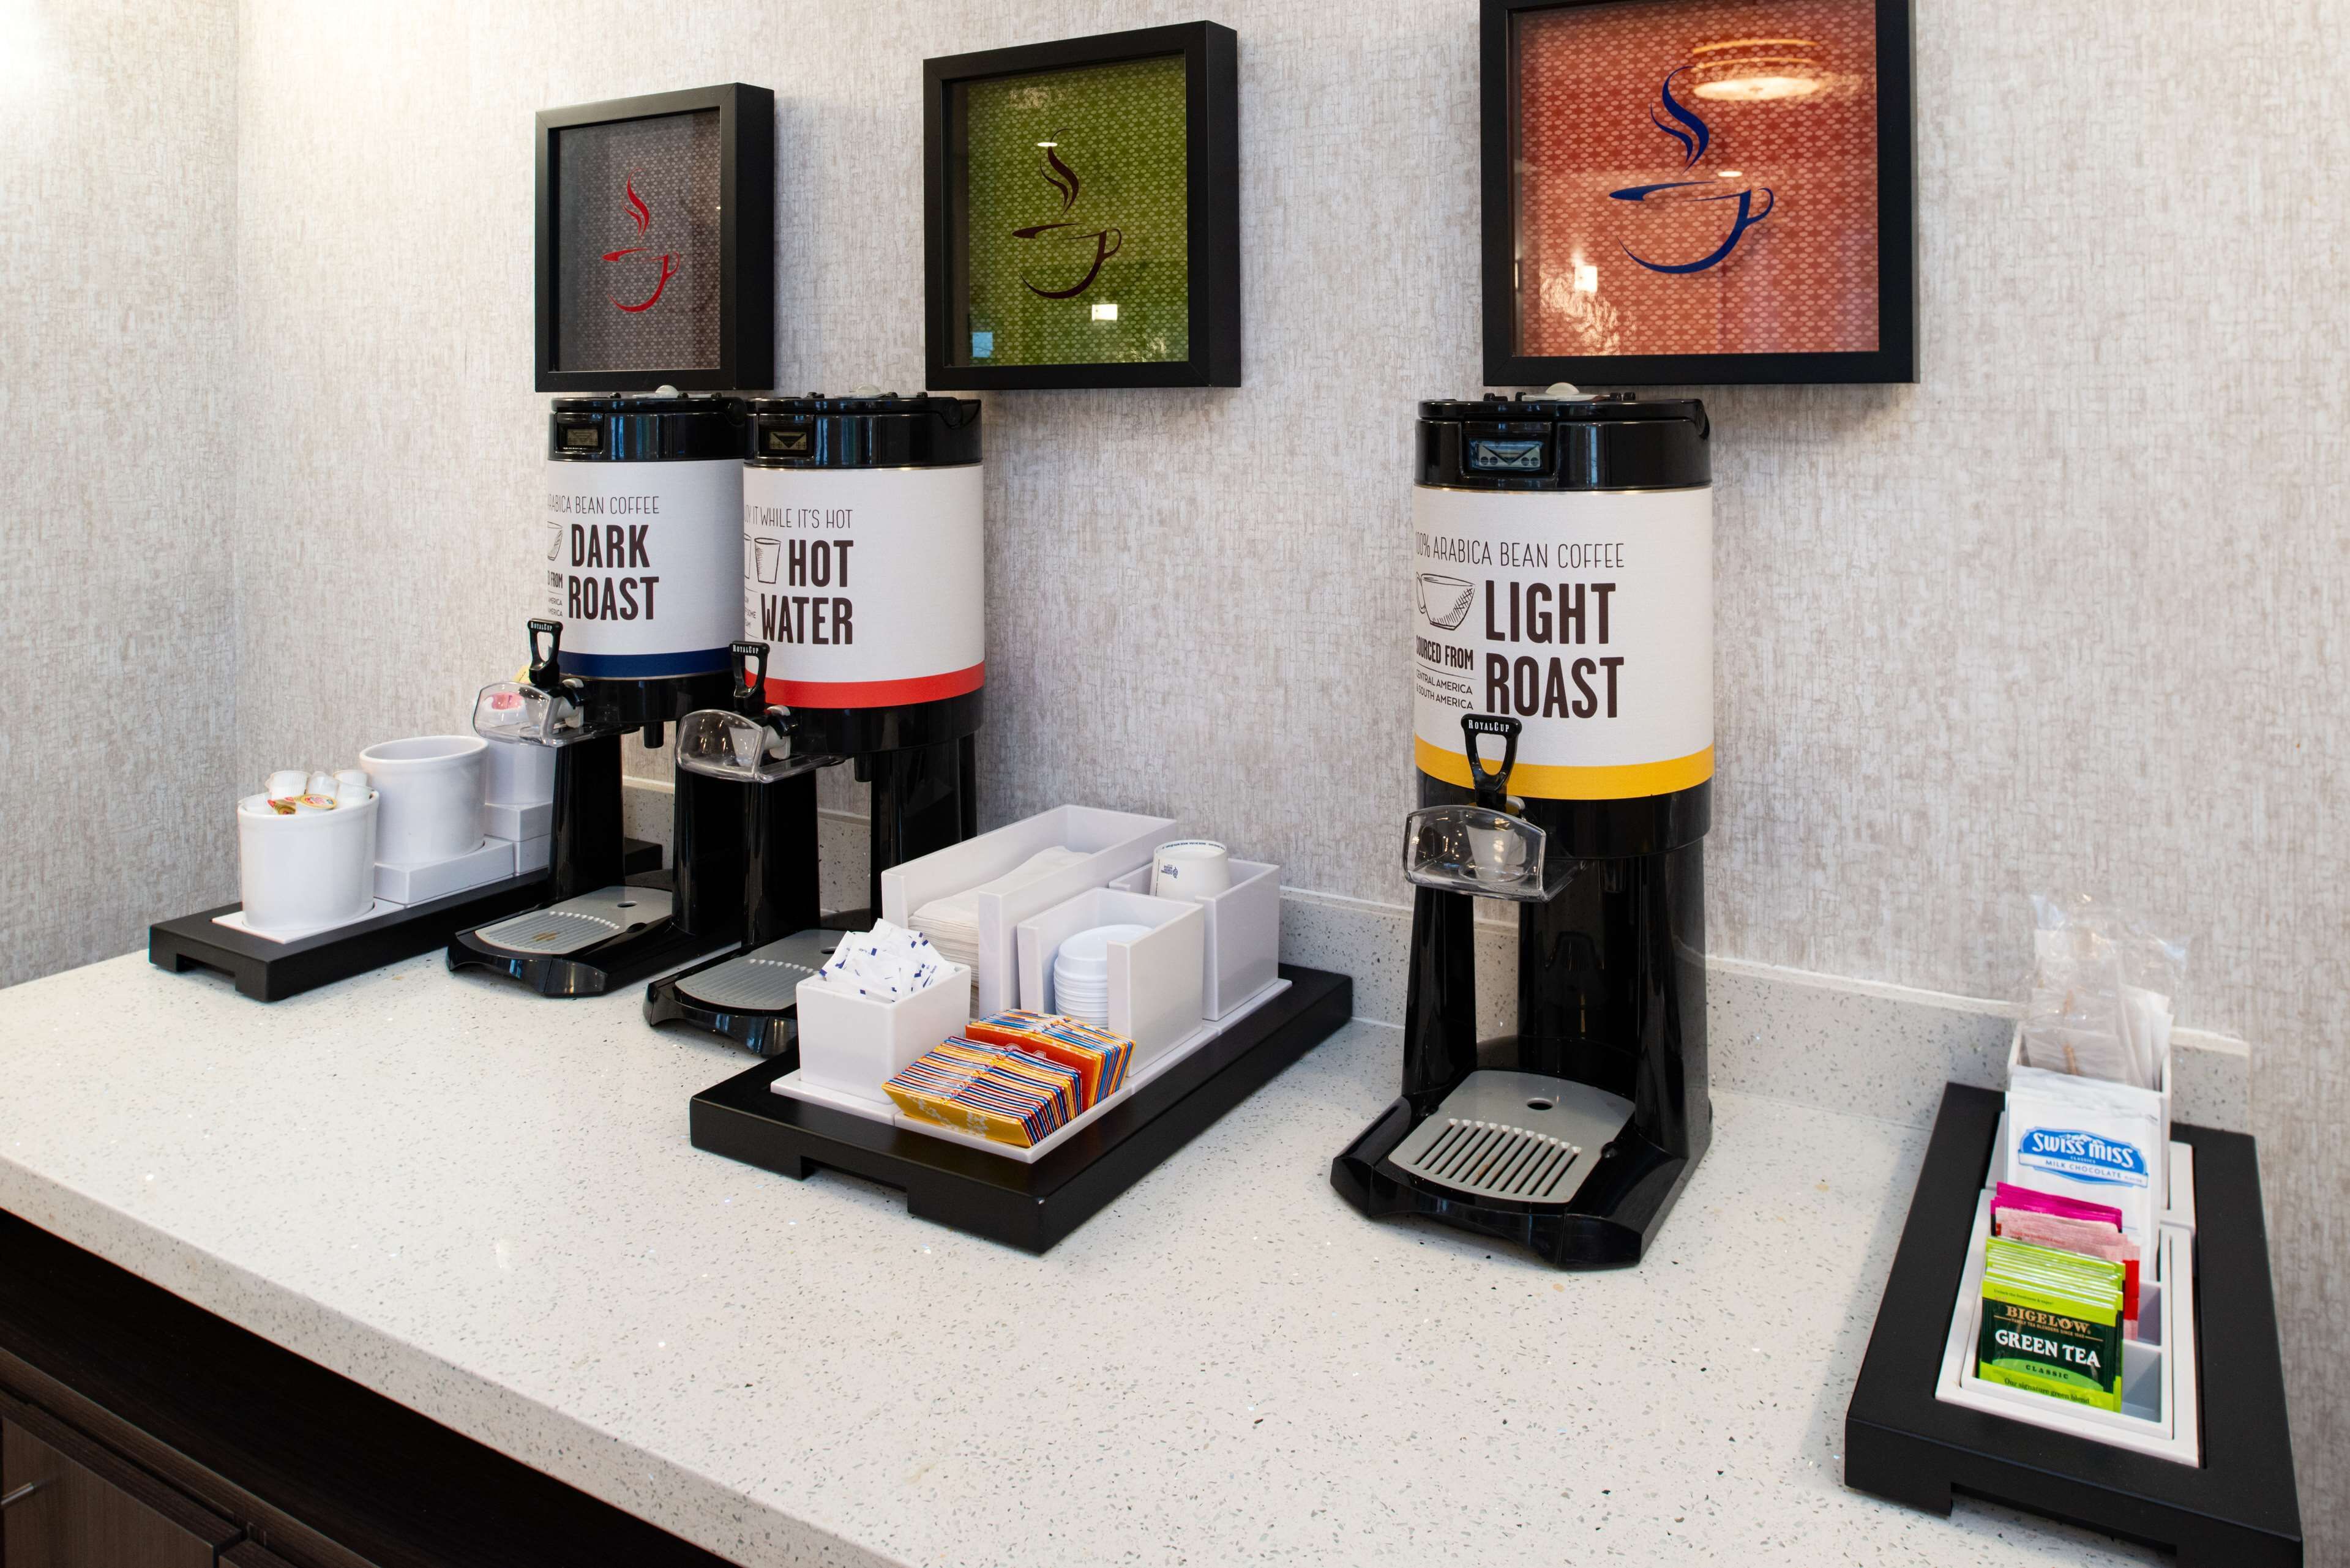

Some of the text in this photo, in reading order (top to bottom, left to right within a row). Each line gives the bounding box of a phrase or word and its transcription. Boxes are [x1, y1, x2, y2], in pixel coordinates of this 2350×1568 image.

[575, 496, 604, 514] BEAN
[610, 496, 659, 514] COFFEE
[760, 507, 791, 528] WHILE
[798, 509, 820, 529] IT'S
[826, 509, 853, 529] HOT
[572, 524, 650, 568] DARK
[1433, 536, 1492, 566] ARABICA
[1500, 542, 1547, 567] BEAN
[1558, 543, 1625, 568] COFFEE
[789, 539, 854, 588] HOT
[569, 575, 659, 621] ROAST
[1486, 580, 1615, 644] LIGHT
[761, 593, 853, 644] WATER
[1445, 644, 1473, 671] FROM
[1419, 685, 1435, 700] SOUTH
[1435, 693, 1474, 710] AMERICA
[1436, 679, 1473, 695] AMERICA
[1486, 652, 1624, 718] ROAST
[2045, 1160, 2066, 1168] MILK
[2069, 1162, 2121, 1179] CHOCOLATE
[2006, 1305, 2090, 1334] BIGELOW
[1995, 1329, 2101, 1368] GREEN TEA
[2025, 1364, 2069, 1379] CLASSIC
[2004, 1378, 2090, 1404] Our signature green blend
